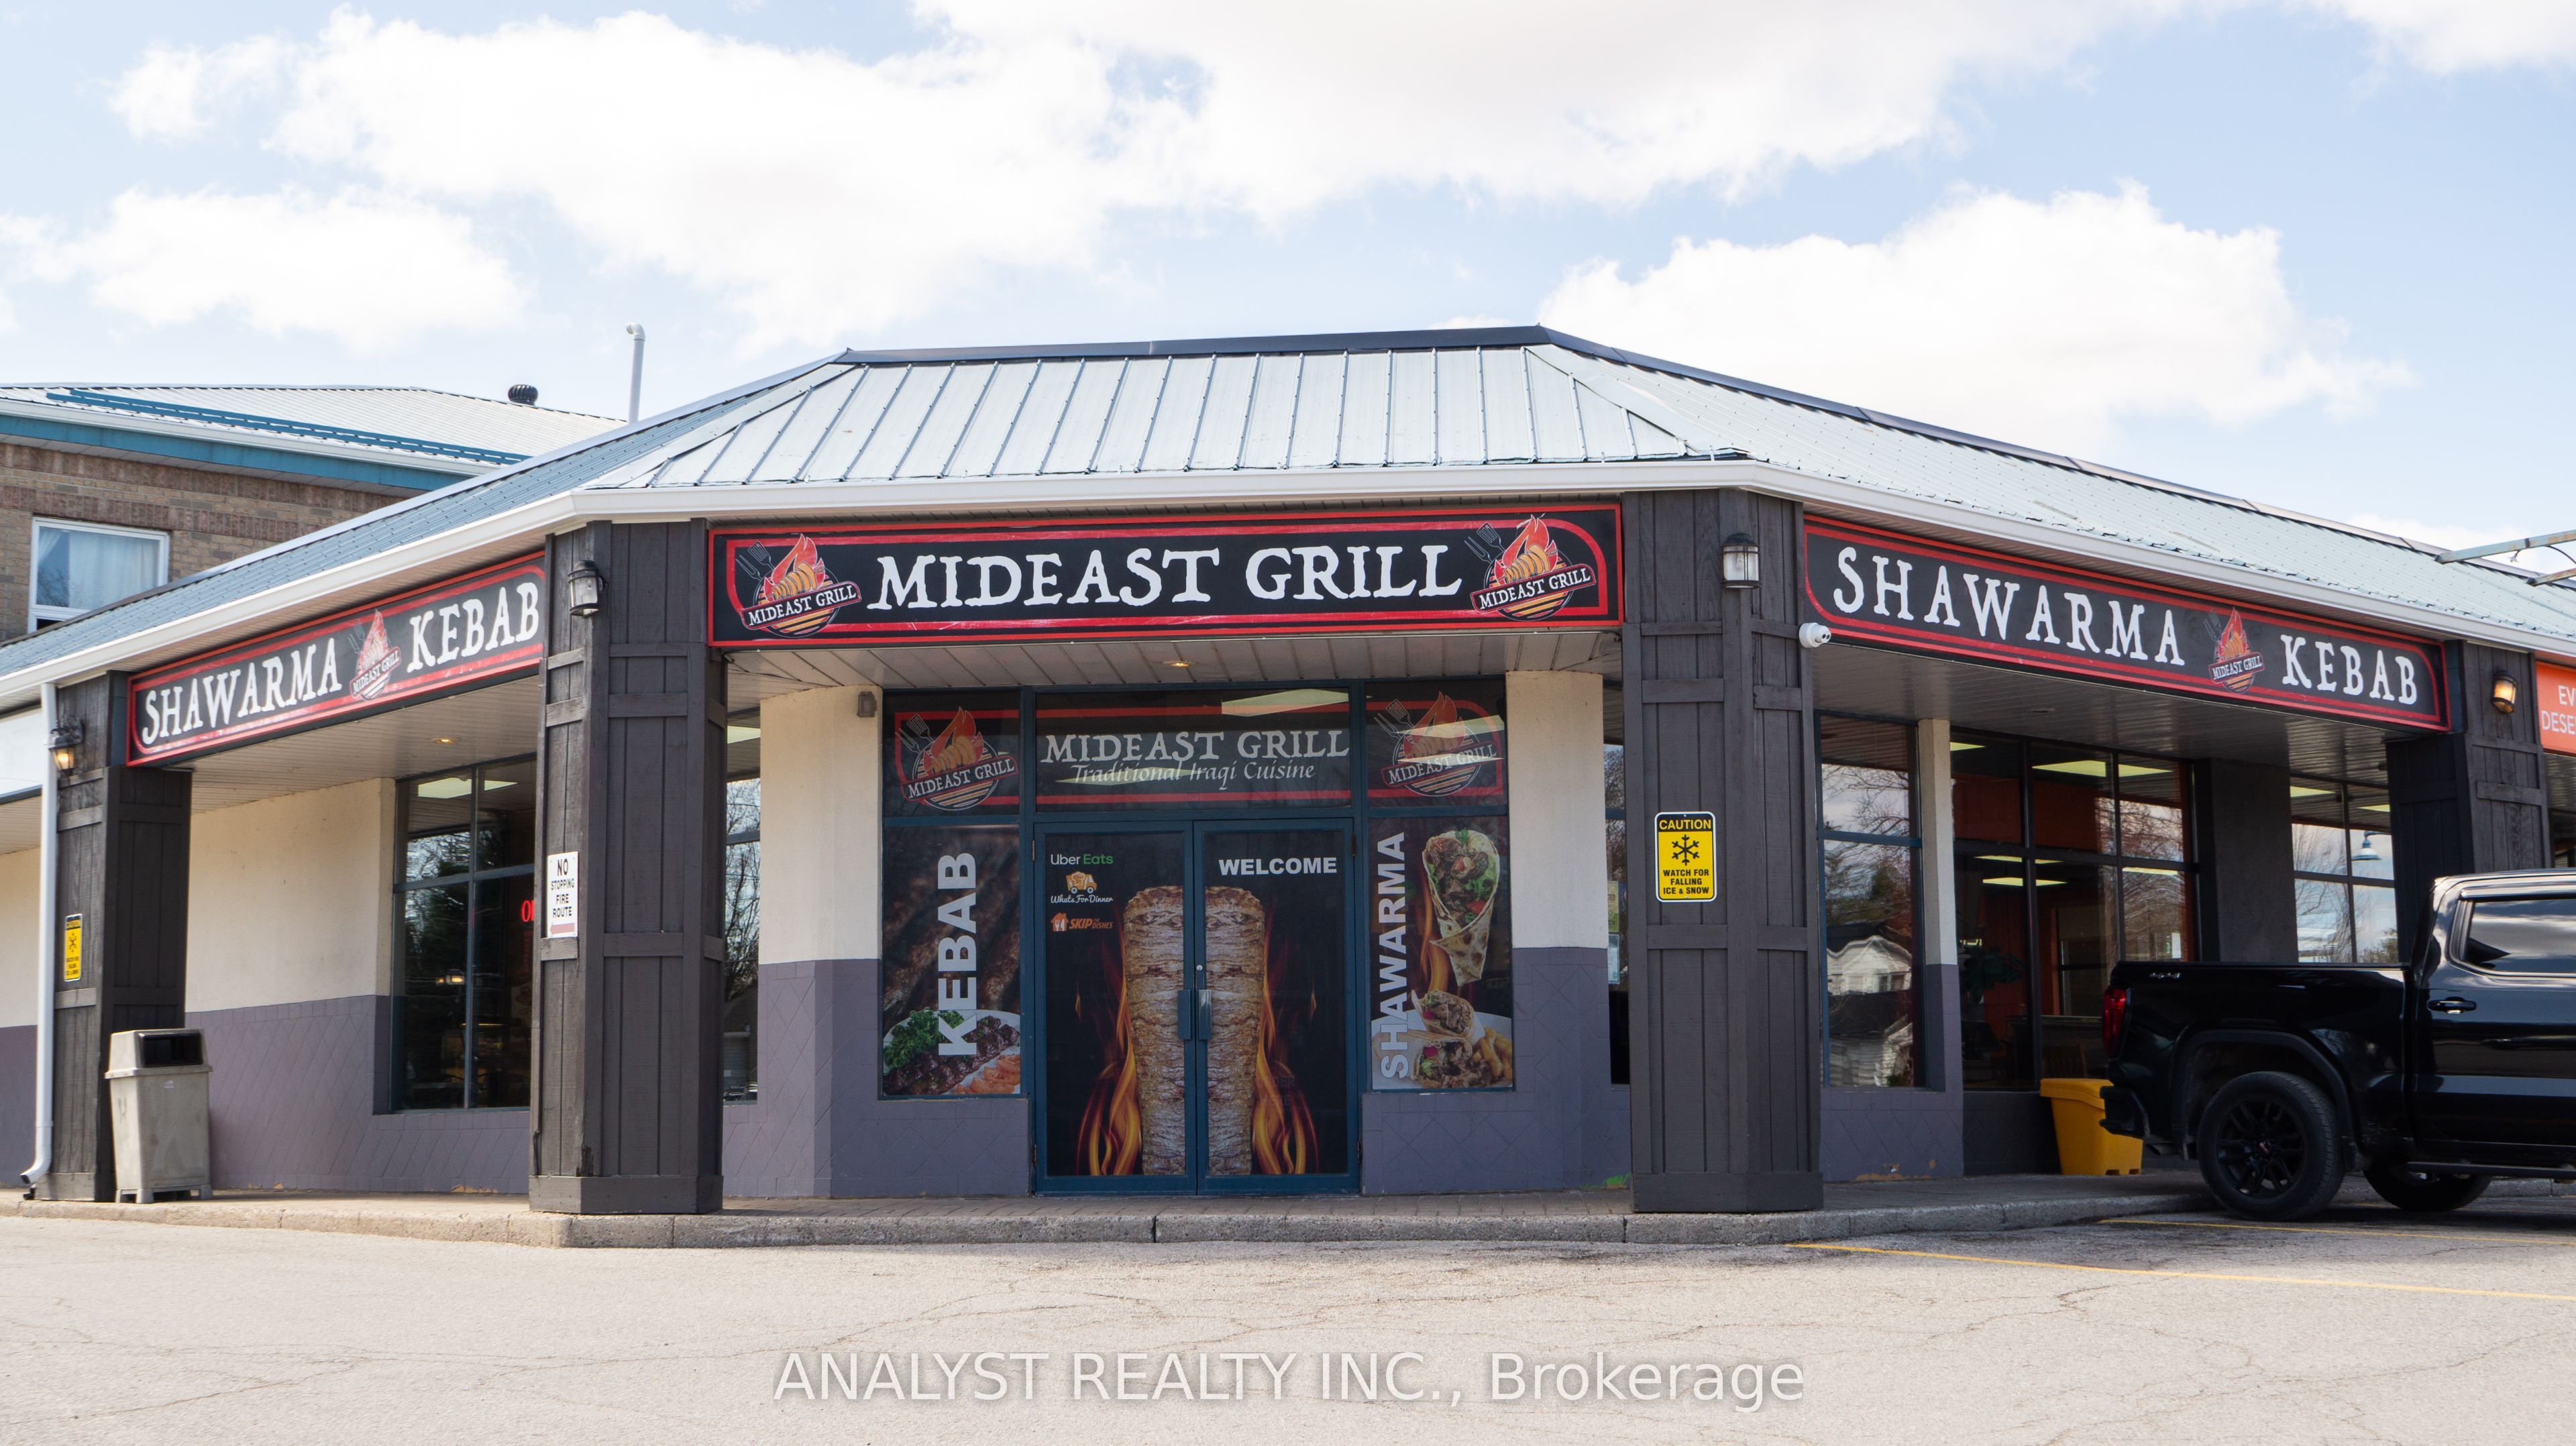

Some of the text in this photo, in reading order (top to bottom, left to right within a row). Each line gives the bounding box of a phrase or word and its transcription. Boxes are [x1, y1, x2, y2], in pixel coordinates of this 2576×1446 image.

[867, 545, 1462, 610] MIDEAST GRILL
[1479, 568, 1591, 610] MIDEAST GRILL
[748, 583, 857, 626] MIDEAST GRILL
[1833, 546, 2417, 705] SHAWARMA KEBAB
[142, 582, 539, 744] SHAWARMA KEBAB
[2212, 656, 2263, 680] MIDEAST GRILL
[2558, 685, 2576, 706] EV
[2541, 710, 2576, 735] DESE
[1040, 730, 1350, 763] MIDEAST GRILL
[1070, 759, 1316, 790] Traditional Iraqi Cuisine
[1388, 744, 1498, 785] MIDEAST GRILL
[908, 759, 1015, 799] MIDEAST GRILL
[1659, 819, 1712, 830] CAUTION
[557, 858, 569, 876] NO
[1051, 854, 1114, 865] Uber Eats
[1218, 857, 1337, 875] WELCOME
[551, 878, 575, 891] STOPPING
[553, 907, 572, 918] ROUTE
[556, 893, 569, 905] FIRE
[1069, 918, 1093, 929] SKIP
[937, 853, 977, 1056] KEBAB
[1377, 832, 1409, 1079] SHAWARMA
